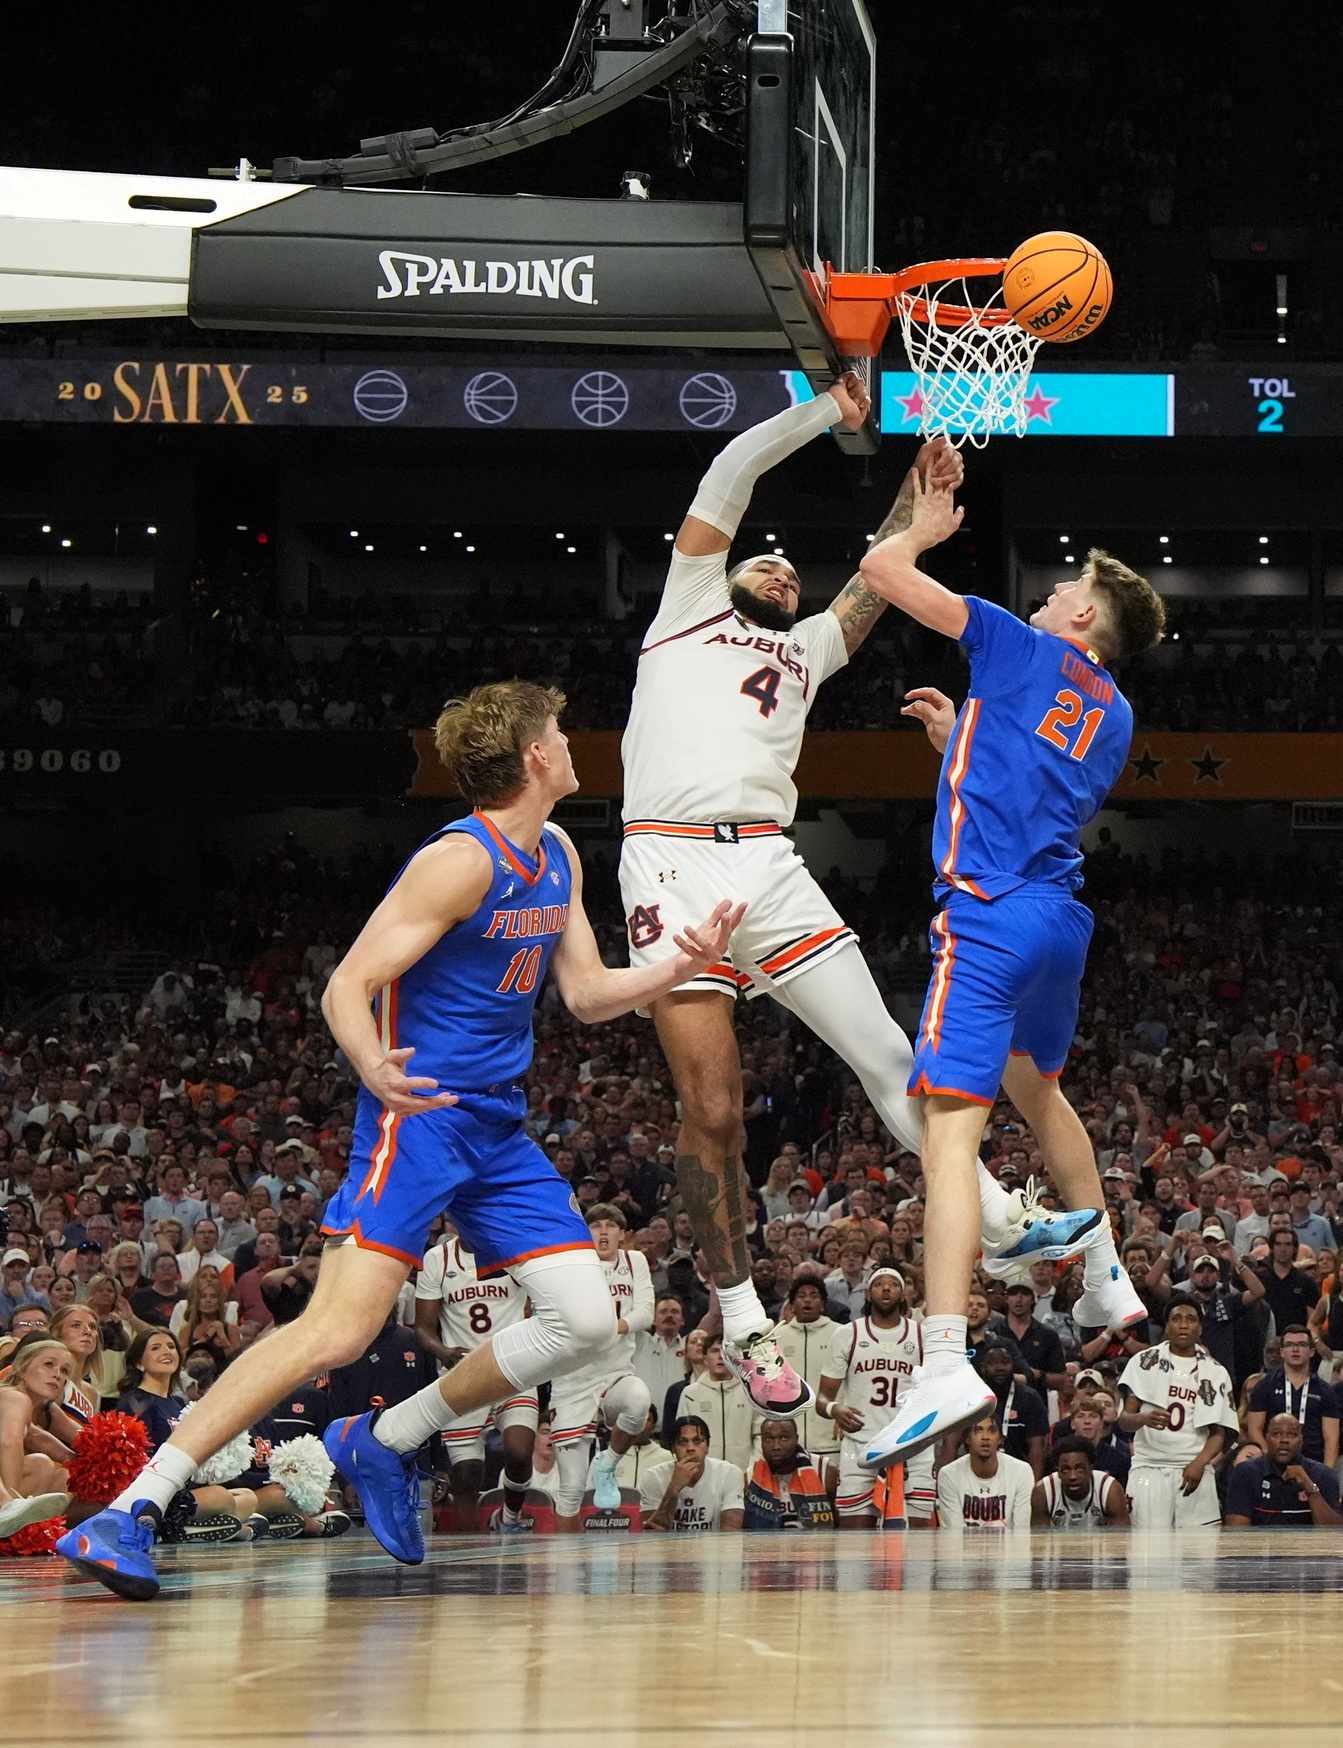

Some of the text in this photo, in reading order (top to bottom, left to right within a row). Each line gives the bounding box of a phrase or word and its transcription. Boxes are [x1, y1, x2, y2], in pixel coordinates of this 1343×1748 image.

[377, 250, 594, 305] SPALDING
[1027, 294, 1073, 331] NCAA
[112, 361, 253, 425] SATX
[1248, 378, 1296, 398] TOL
[1257, 399, 1284, 432] 2
[740, 665, 782, 719] 4
[1034, 688, 1105, 762] 21
[496, 944, 543, 994] 10
[448, 1283, 509, 1306] AUBURN
[468, 1302, 492, 1335] 8
[869, 1375, 899, 1408] 31
[1166, 1402, 1185, 1432] 0
[585, 1517, 630, 1527] FINAL FOUR
